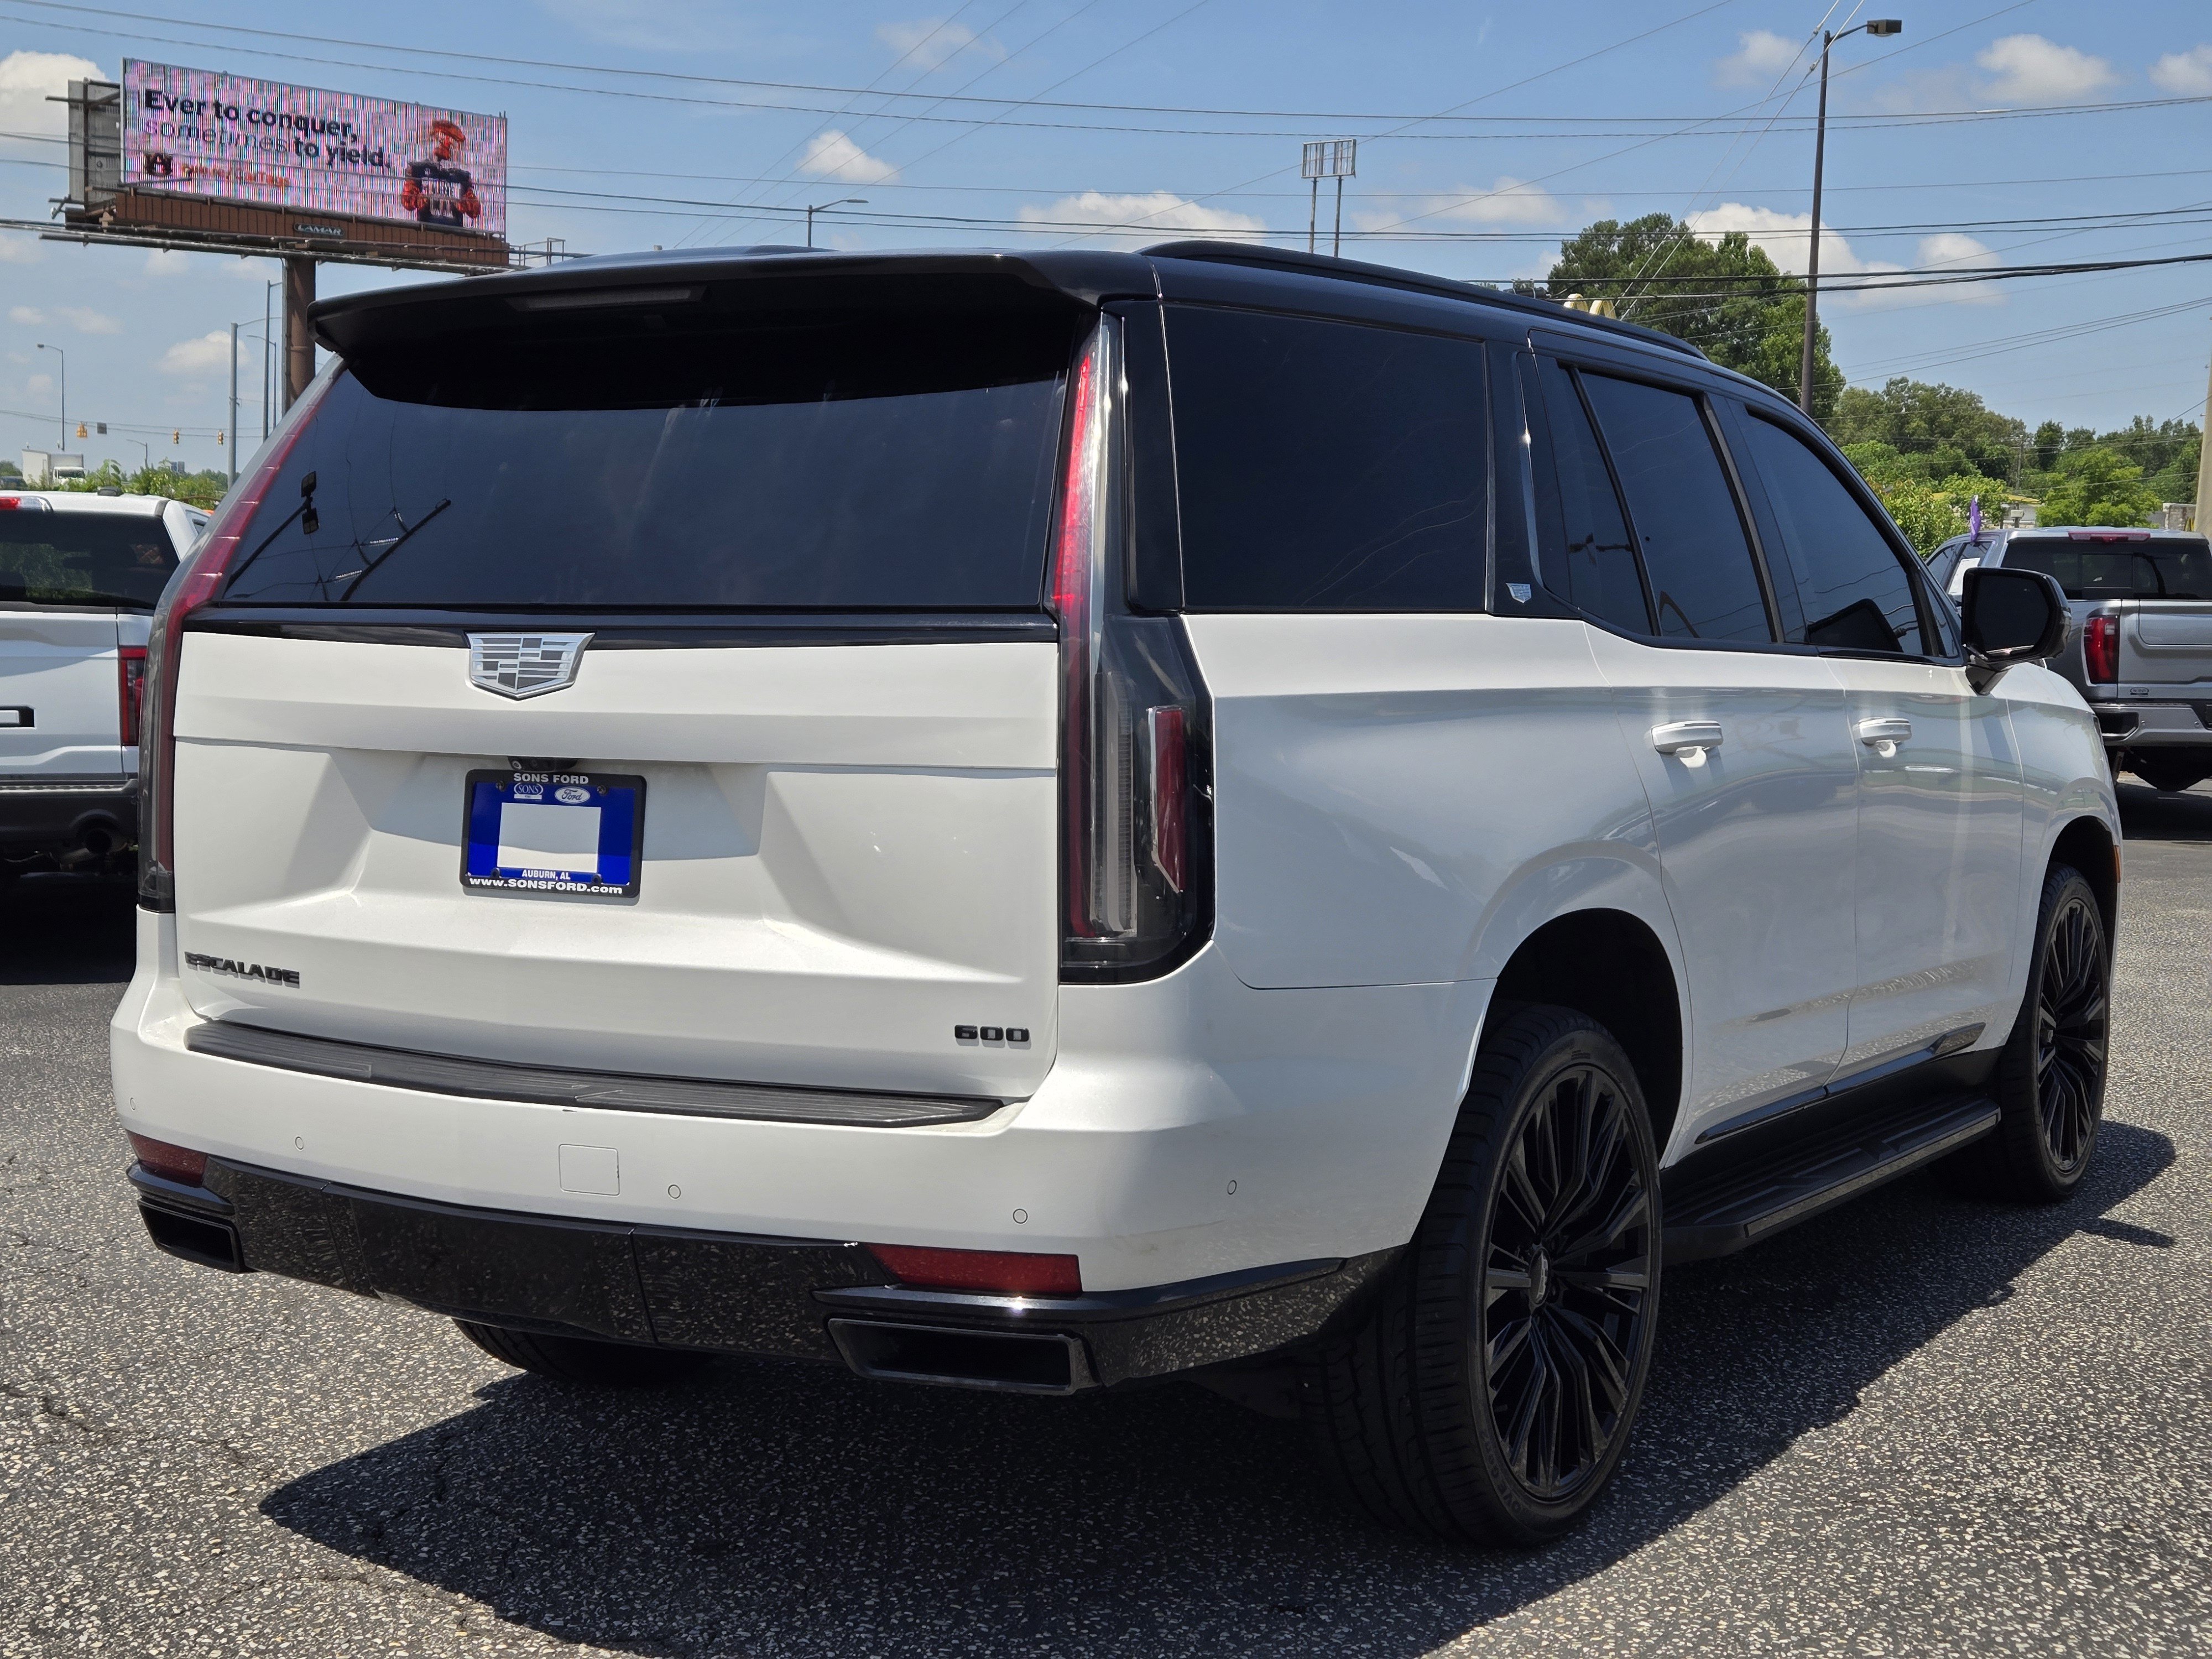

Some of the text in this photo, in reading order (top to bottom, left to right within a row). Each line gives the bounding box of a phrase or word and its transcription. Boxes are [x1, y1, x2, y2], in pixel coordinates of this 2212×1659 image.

[145, 89, 357, 142] Ever to conquer,
[146, 119, 391, 169] sometimes to yield.
[298, 225, 341, 236] LAMAR
[514, 773, 589, 784] SONS FORD
[518, 785, 582, 801] SONS Ford
[521, 869, 559, 880] AUBURN,
[469, 878, 623, 894] www.SONSFORD.com
[184, 951, 300, 984] ESCALADE
[954, 1025, 1030, 1042] 600
